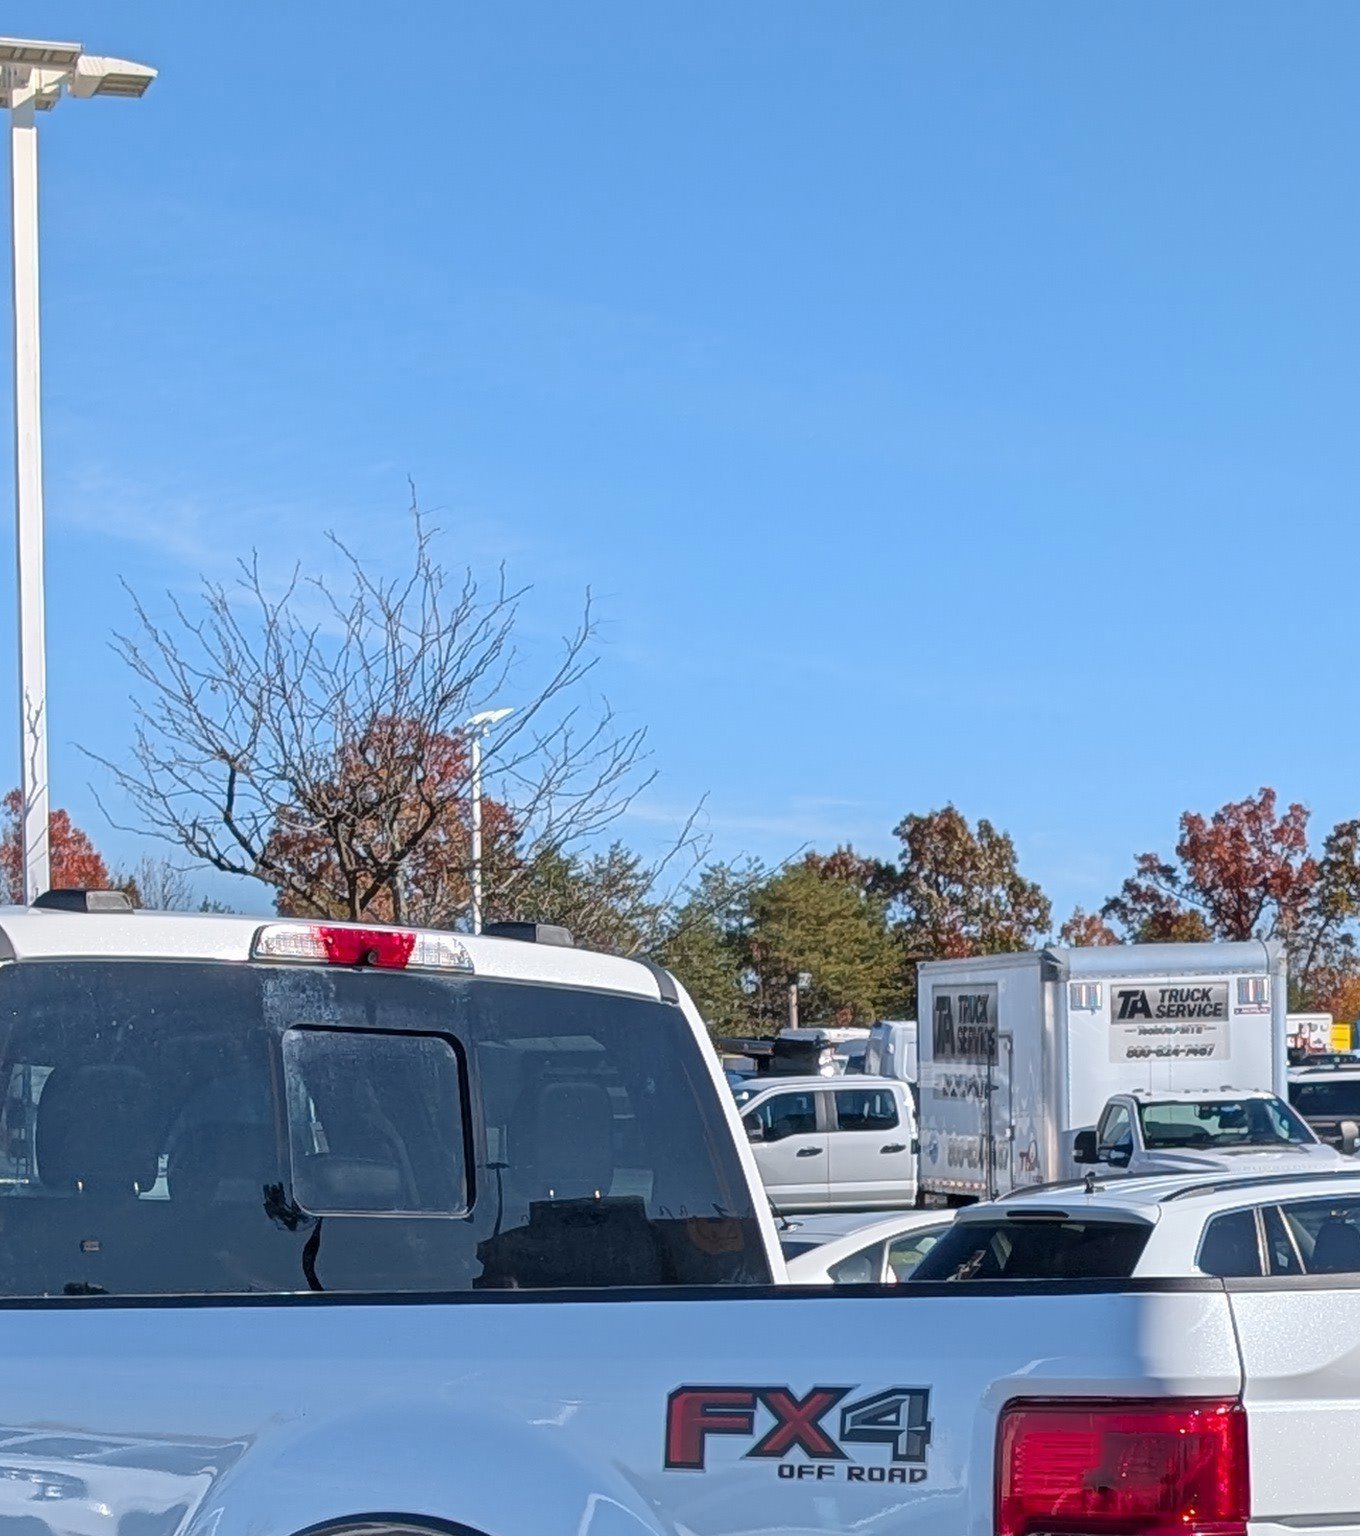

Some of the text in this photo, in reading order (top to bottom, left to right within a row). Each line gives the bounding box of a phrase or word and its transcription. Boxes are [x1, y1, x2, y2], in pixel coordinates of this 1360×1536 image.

[1117, 990, 1153, 1019] TA
[1159, 988, 1213, 1003] TRUCK
[1155, 1003, 1223, 1019] SERVICE
[662, 1382, 933, 1473] FX4
[777, 1463, 928, 1484] OFF ROAD
